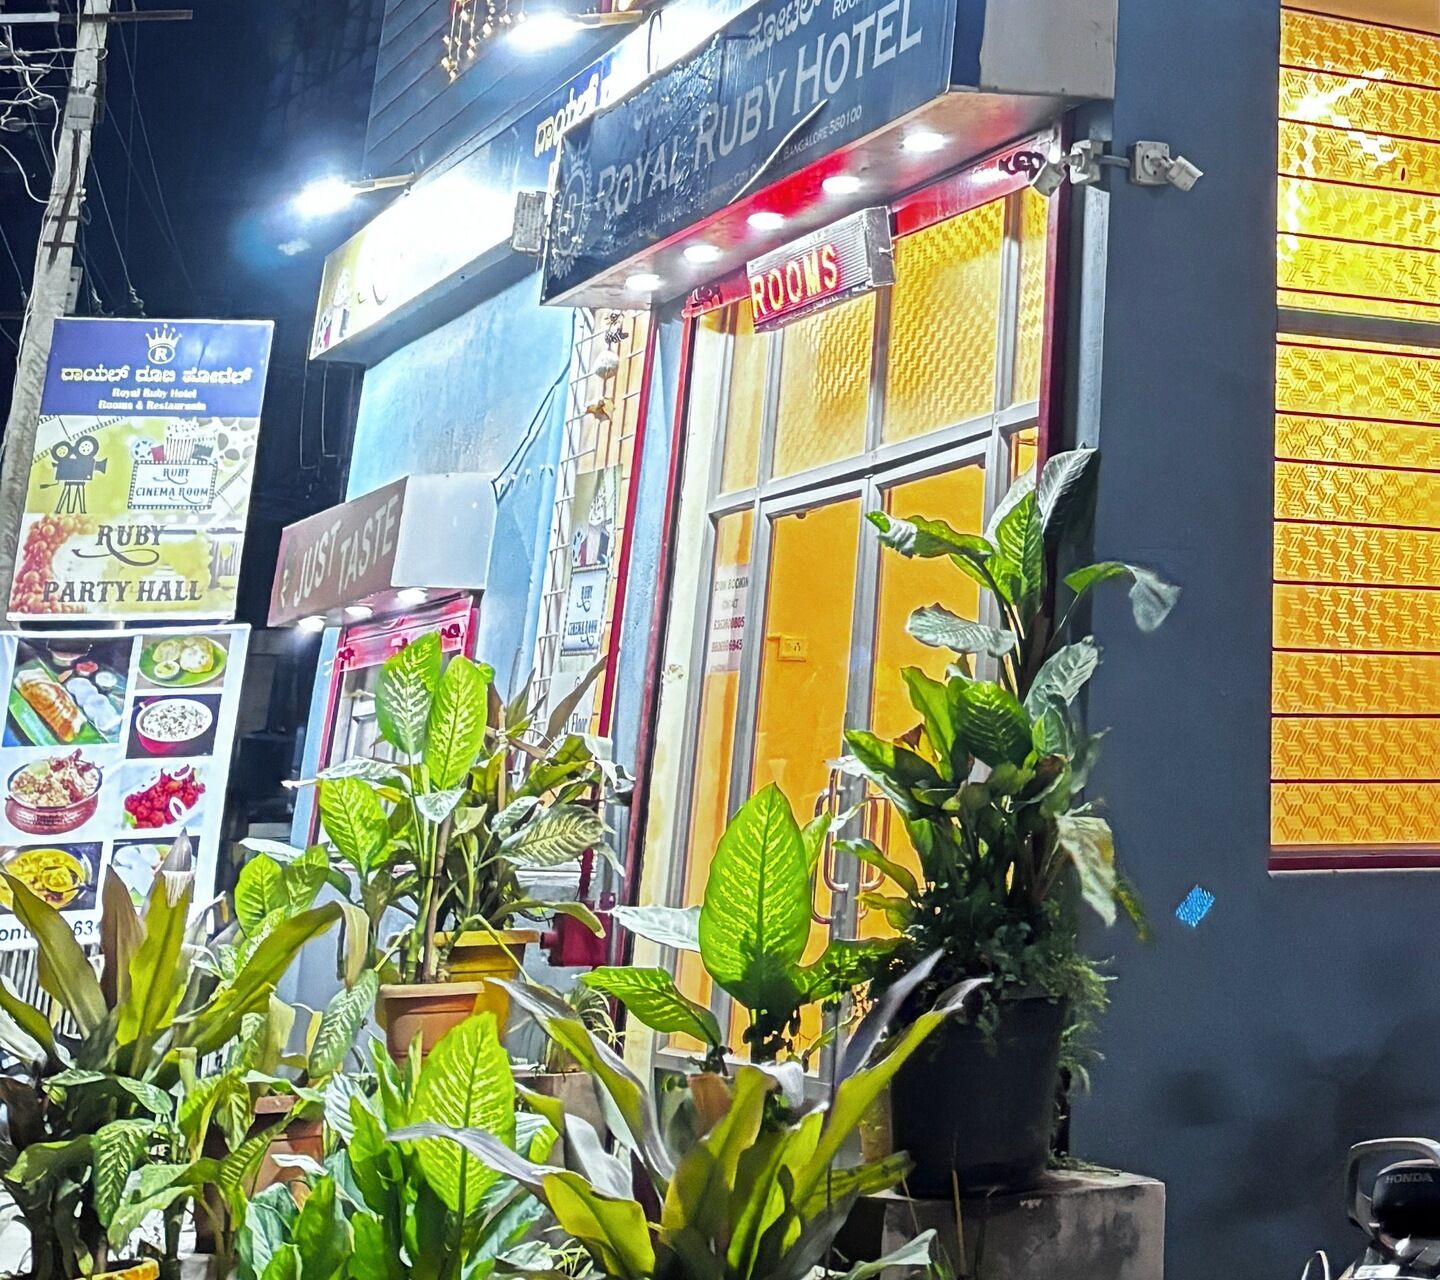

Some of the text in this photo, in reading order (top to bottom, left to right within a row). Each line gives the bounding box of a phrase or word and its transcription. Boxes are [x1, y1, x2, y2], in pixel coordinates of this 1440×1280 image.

[597, 134, 684, 216] ROYAL
[694, 68, 788, 172] RUBY
[750, 242, 838, 319] ROOMS
[112, 388, 197, 400] Royal Ruby Hotel
[98, 400, 134, 410] Rooms
[135, 487, 208, 502] CINEMA ROOM
[294, 494, 399, 607] JUST TASTE
[42, 580, 203, 603] PARTY HALL
[1384, 1172, 1434, 1184] HONDA
